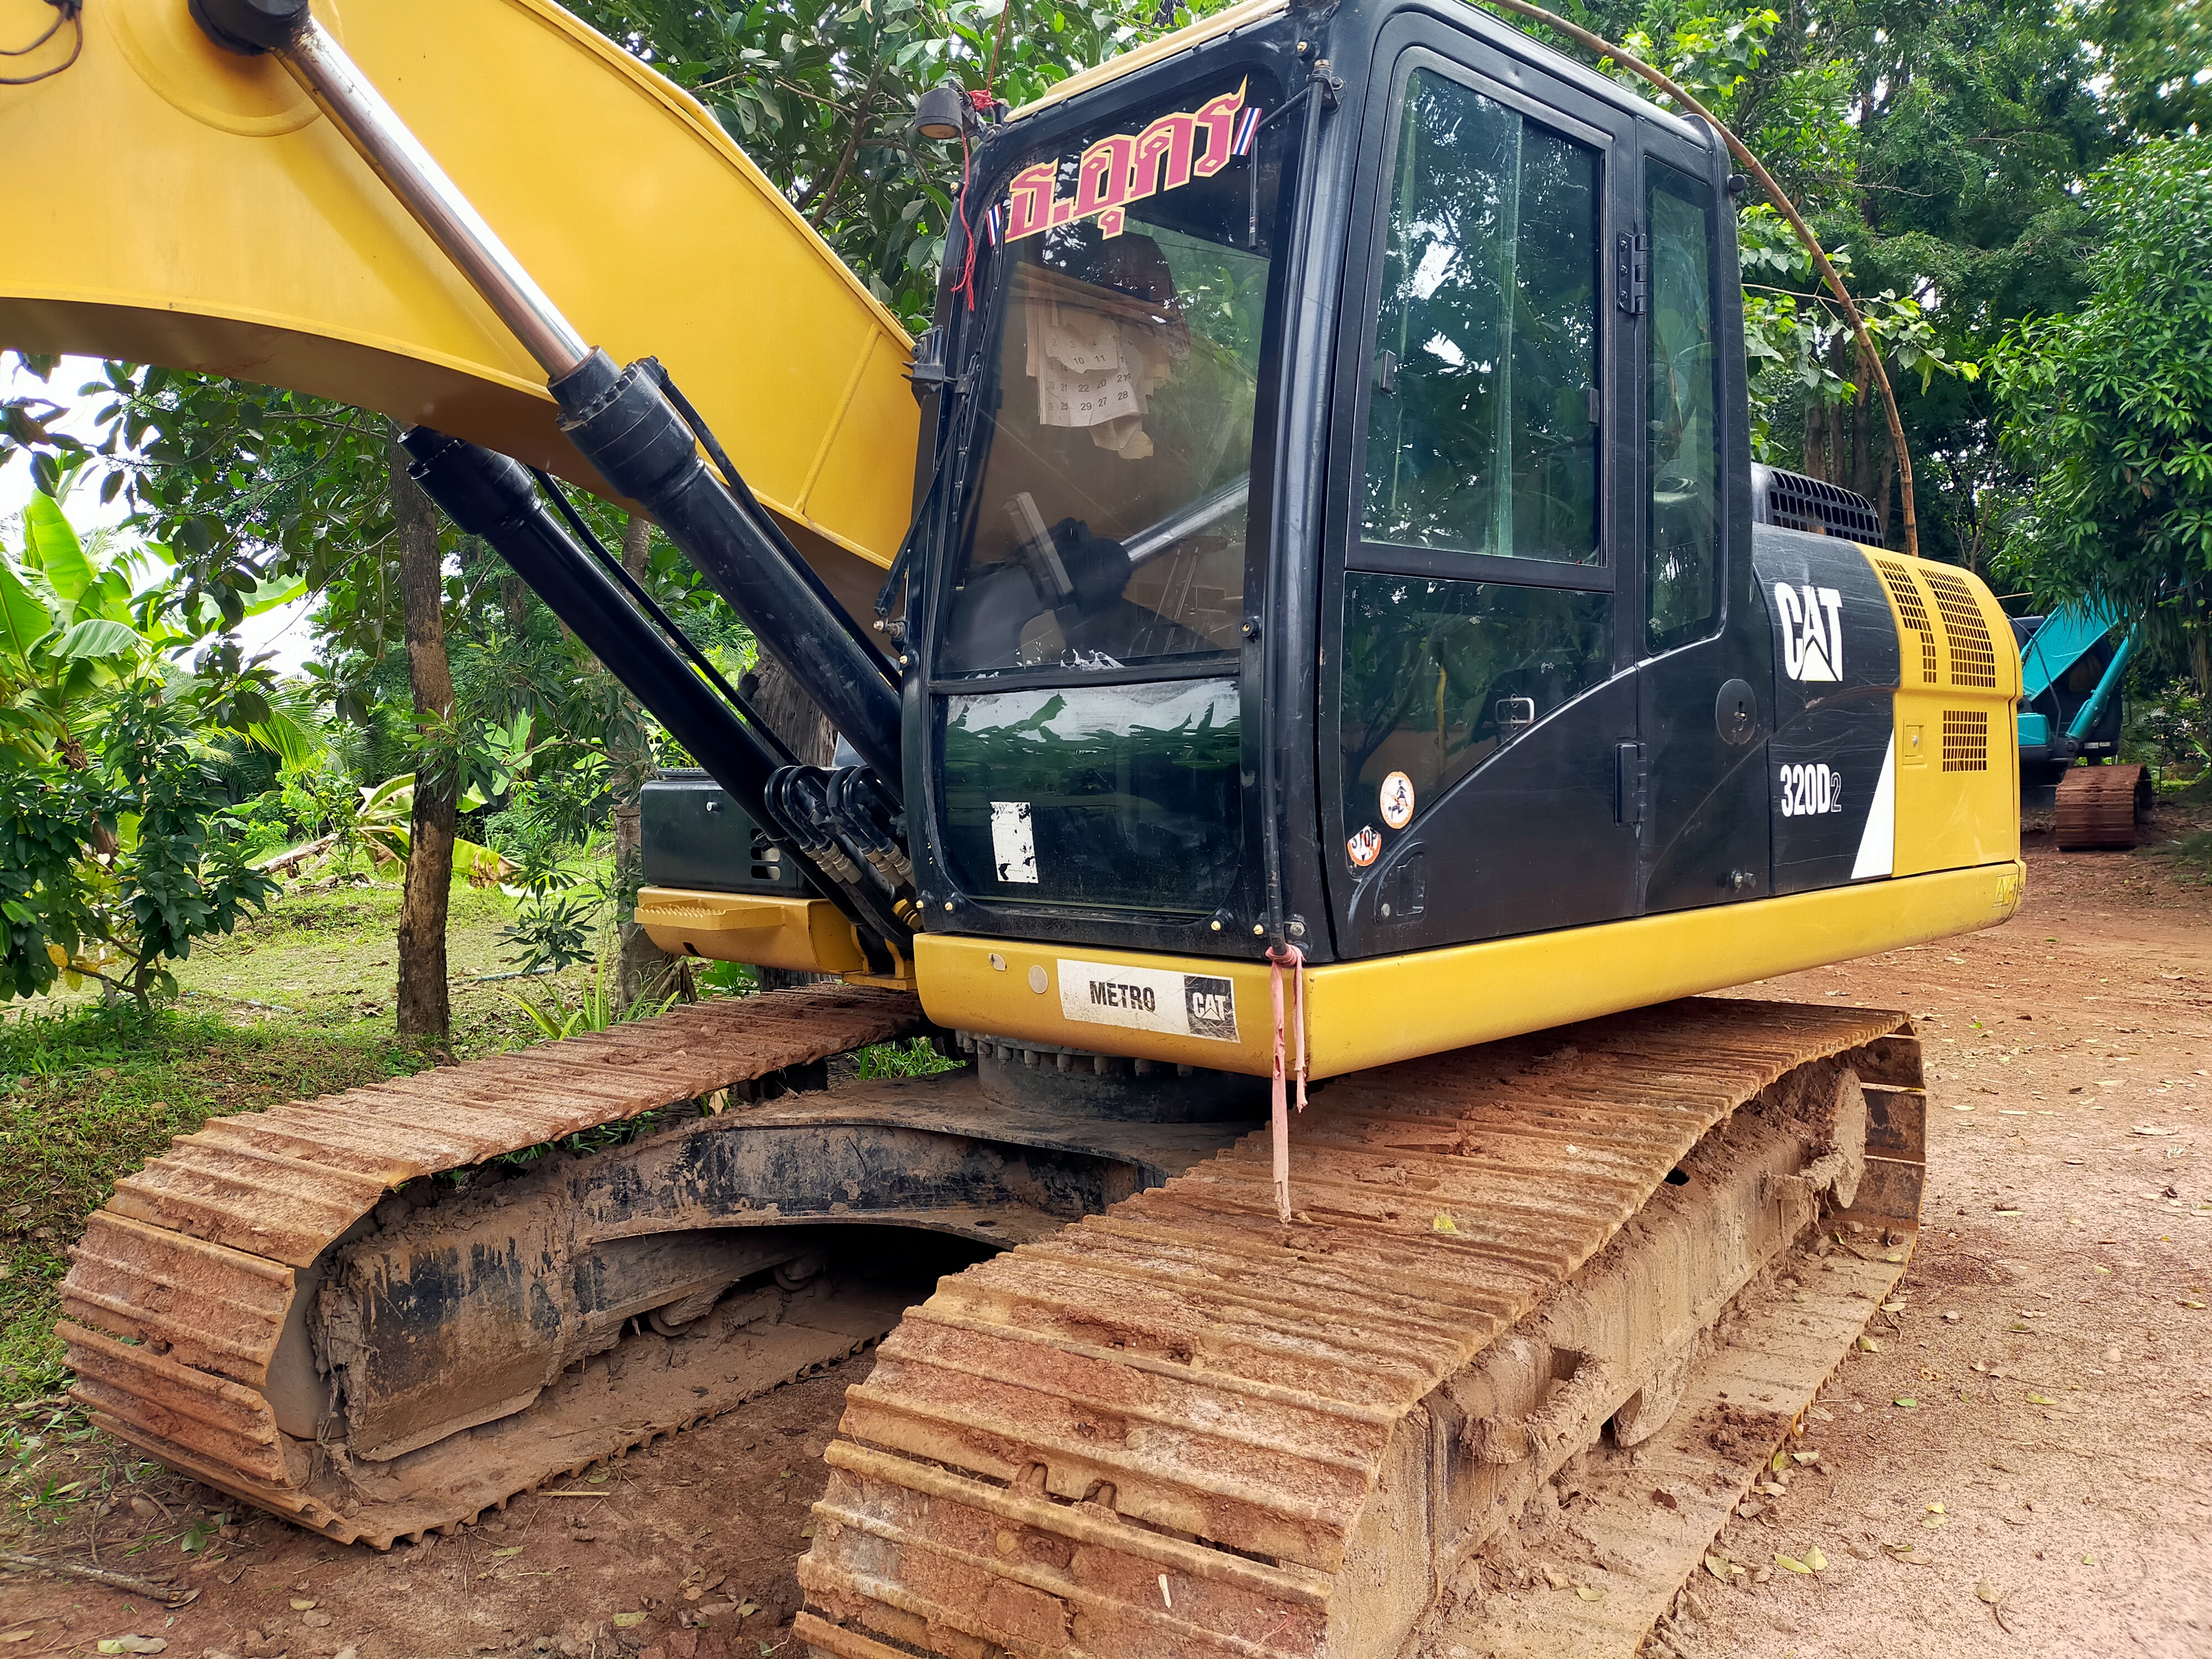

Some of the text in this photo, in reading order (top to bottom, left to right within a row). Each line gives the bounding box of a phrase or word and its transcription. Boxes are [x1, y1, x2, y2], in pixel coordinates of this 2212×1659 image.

[1052, 338, 1057, 346] 2
[1095, 354, 1105, 363] 11
[1061, 383, 1067, 392] 21
[1078, 384, 1089, 392] 22
[1081, 402, 1092, 411] 29
[1098, 397, 1108, 407] 27
[1117, 390, 1128, 401] 28
[1775, 582, 1843, 682] CAT
[1780, 764, 1841, 817] 320D2
[1089, 980, 1227, 1021] METRO CAT
